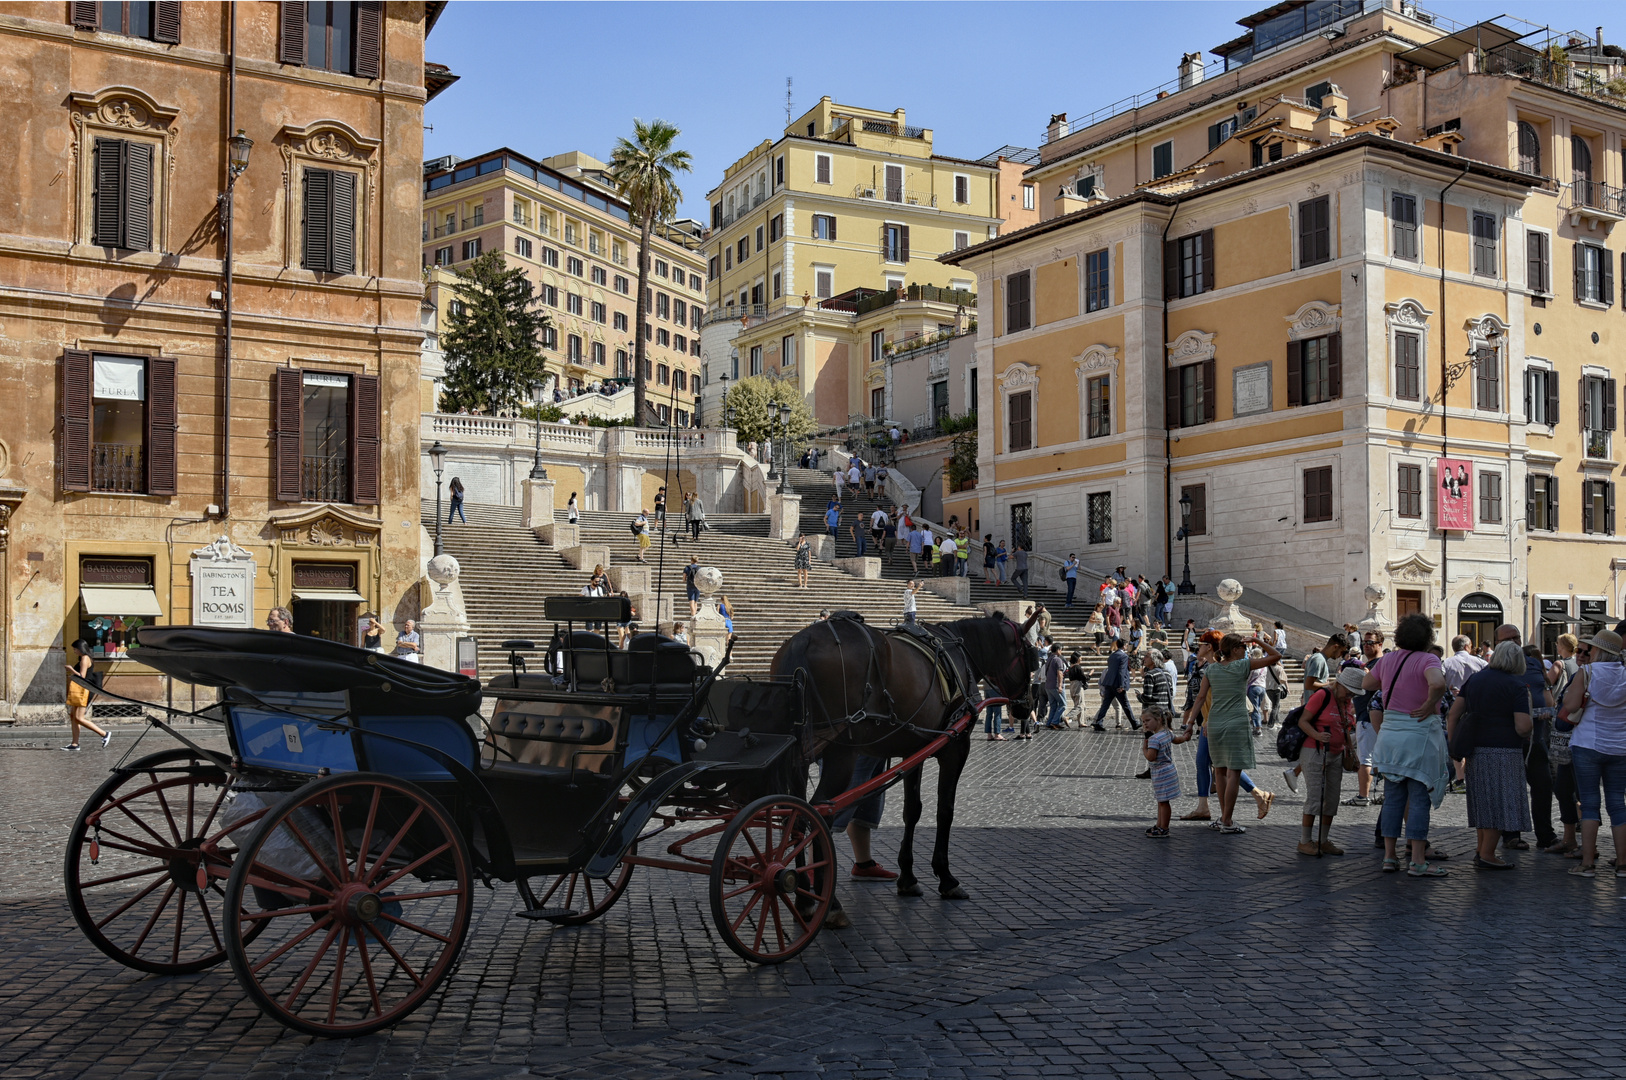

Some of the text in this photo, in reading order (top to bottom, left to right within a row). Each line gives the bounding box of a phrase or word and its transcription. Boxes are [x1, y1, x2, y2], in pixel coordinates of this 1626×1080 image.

[310, 374, 342, 383] FURLA
[101, 387, 137, 396] FURLA
[87, 564, 146, 574] BABINGTONS
[202, 571, 245, 579] BABINGTON'S
[297, 570, 351, 578] BABINGTONS
[210, 586, 236, 597] TEA
[202, 602, 244, 613] ROOMS
[288, 734, 297, 743] 67
